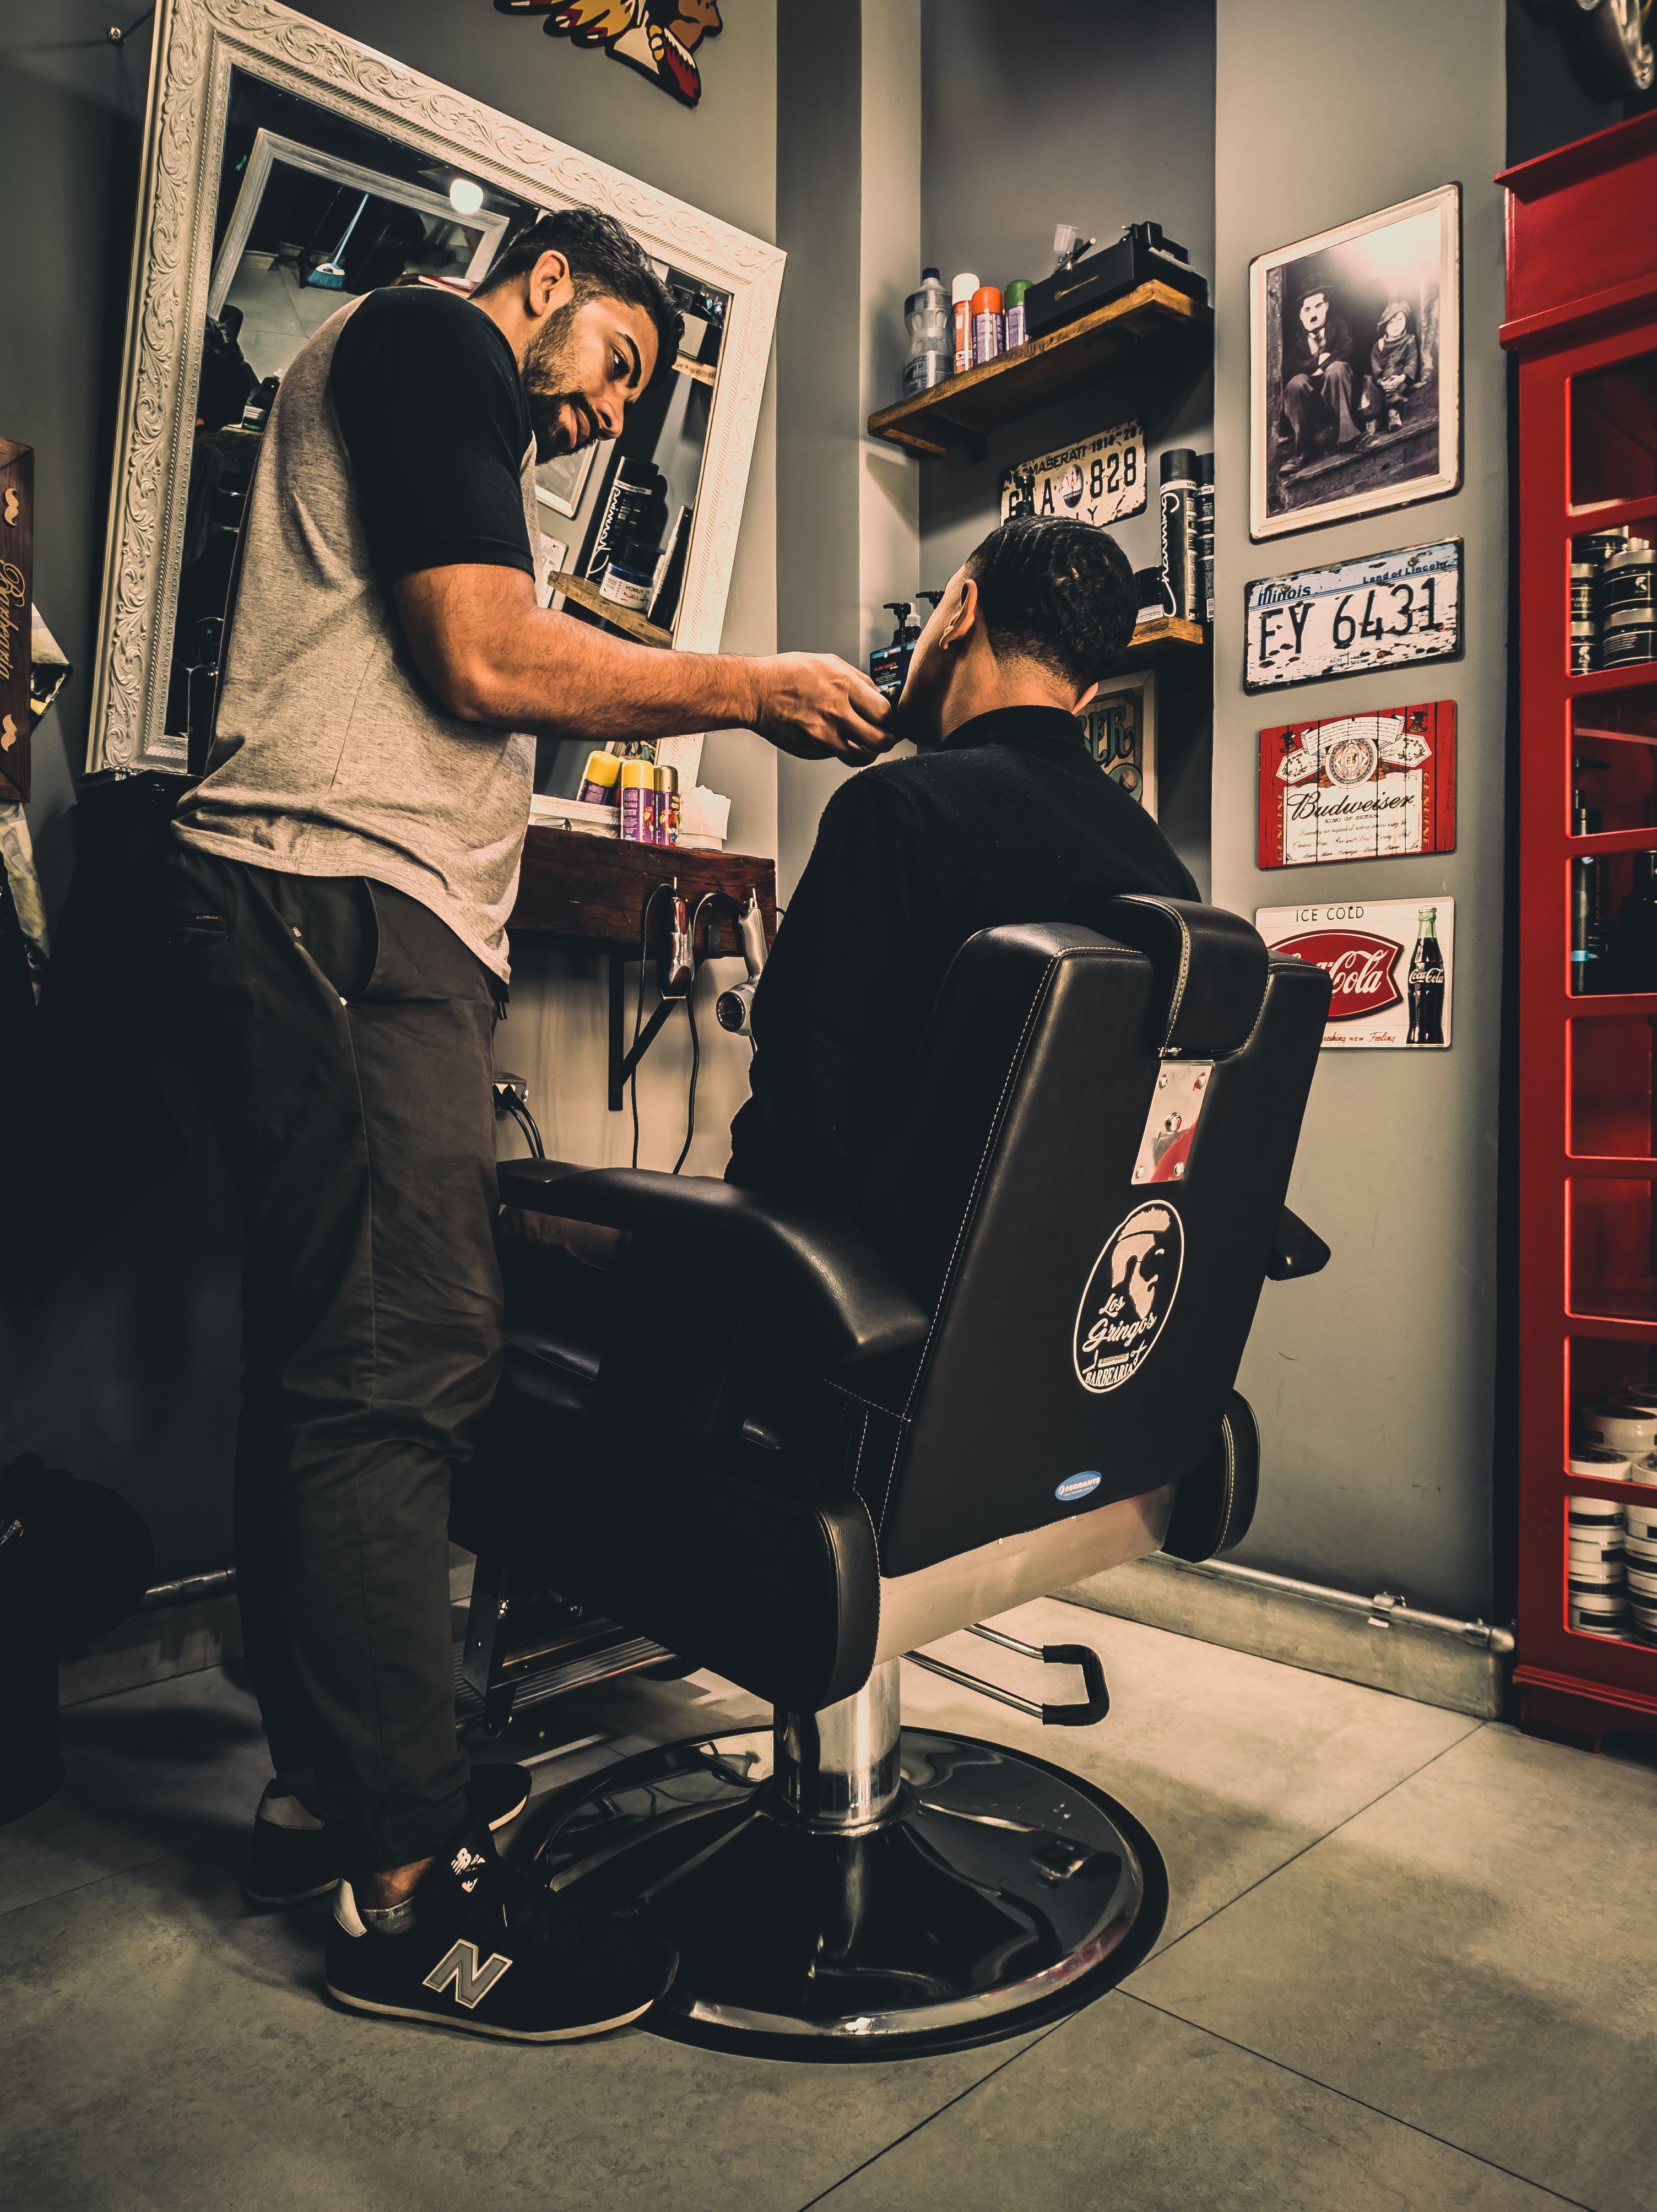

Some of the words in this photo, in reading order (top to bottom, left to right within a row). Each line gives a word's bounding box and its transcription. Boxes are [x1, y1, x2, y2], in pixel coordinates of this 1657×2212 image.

[1028, 445, 1088, 475] MASERATI
[1090, 446, 1137, 499] 828
[1161, 492, 1180, 617] Charming
[1362, 572, 1389, 584] Land
[1391, 568, 1403, 578] of
[1405, 560, 1448, 575] Lincoln
[1257, 585, 1312, 606] Illinois
[1332, 577, 1444, 650] 6431
[1287, 791, 1415, 821] Budweiser
[1296, 909, 1318, 922] ICE
[1326, 906, 1364, 920] COLD
[1322, 1031, 1346, 1044] reshing
[1366, 1032, 1395, 1044] Feeling
[1098, 1293, 1125, 1318] Los
[1082, 1312, 1157, 1352] Gringos
[1085, 1363, 1135, 1387] BARBEARIA
[422, 1938, 513, 2009] N
